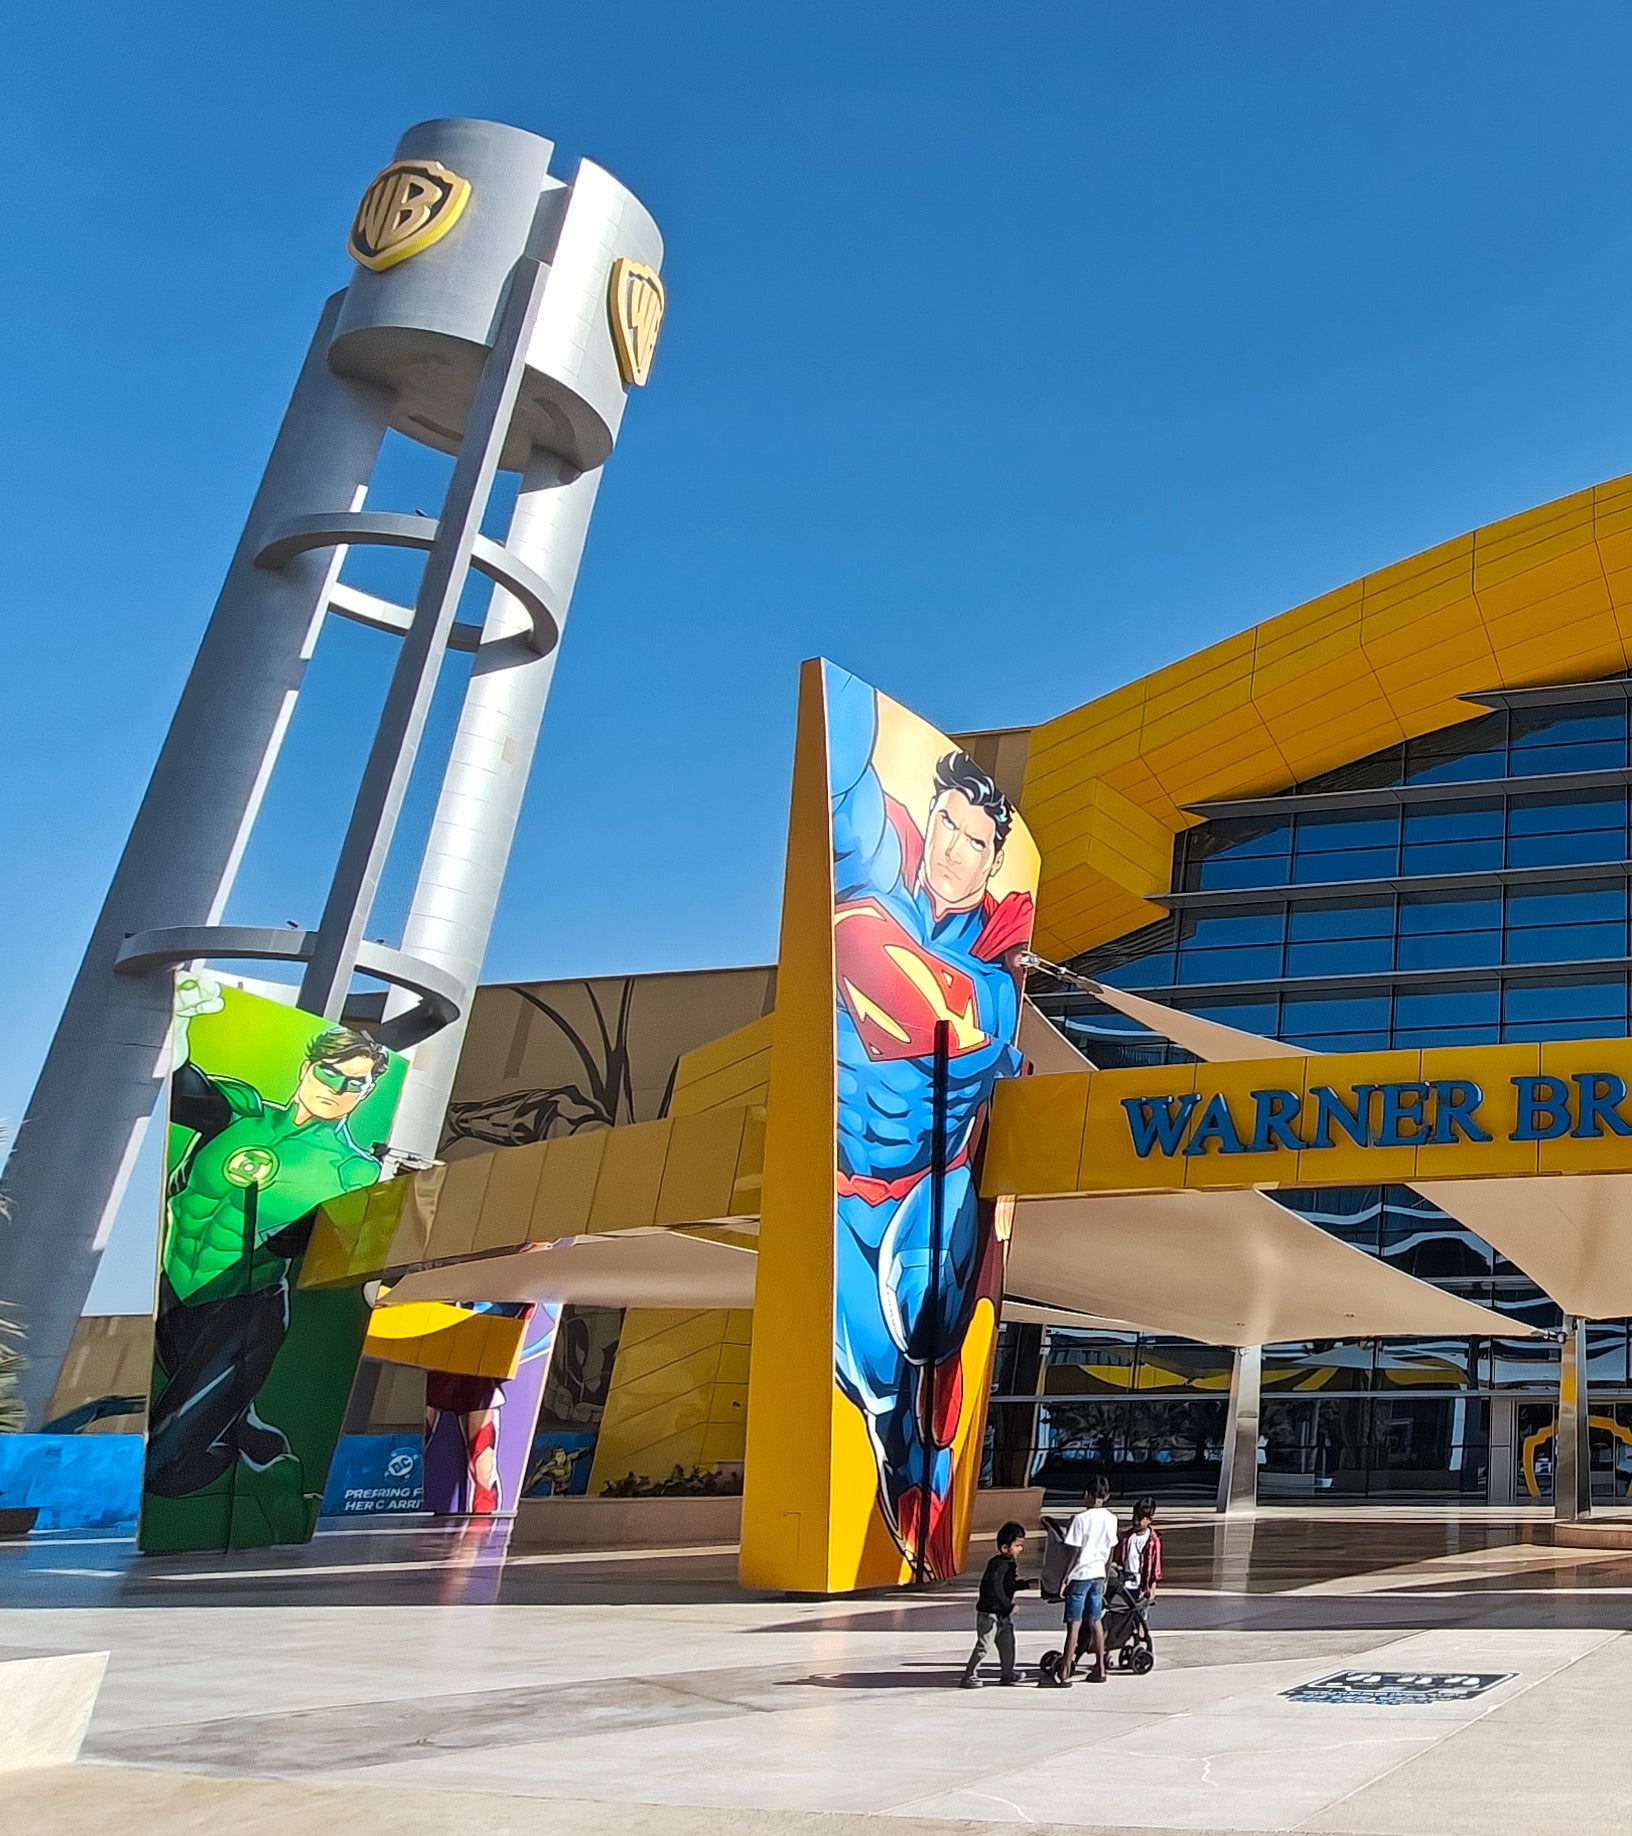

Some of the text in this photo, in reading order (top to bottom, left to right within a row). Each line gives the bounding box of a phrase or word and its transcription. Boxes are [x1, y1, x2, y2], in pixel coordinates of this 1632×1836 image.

[357, 172, 443, 250] WB
[1120, 1079, 1494, 1158] WARNER
[386, 1500, 424, 1510] ARRI
